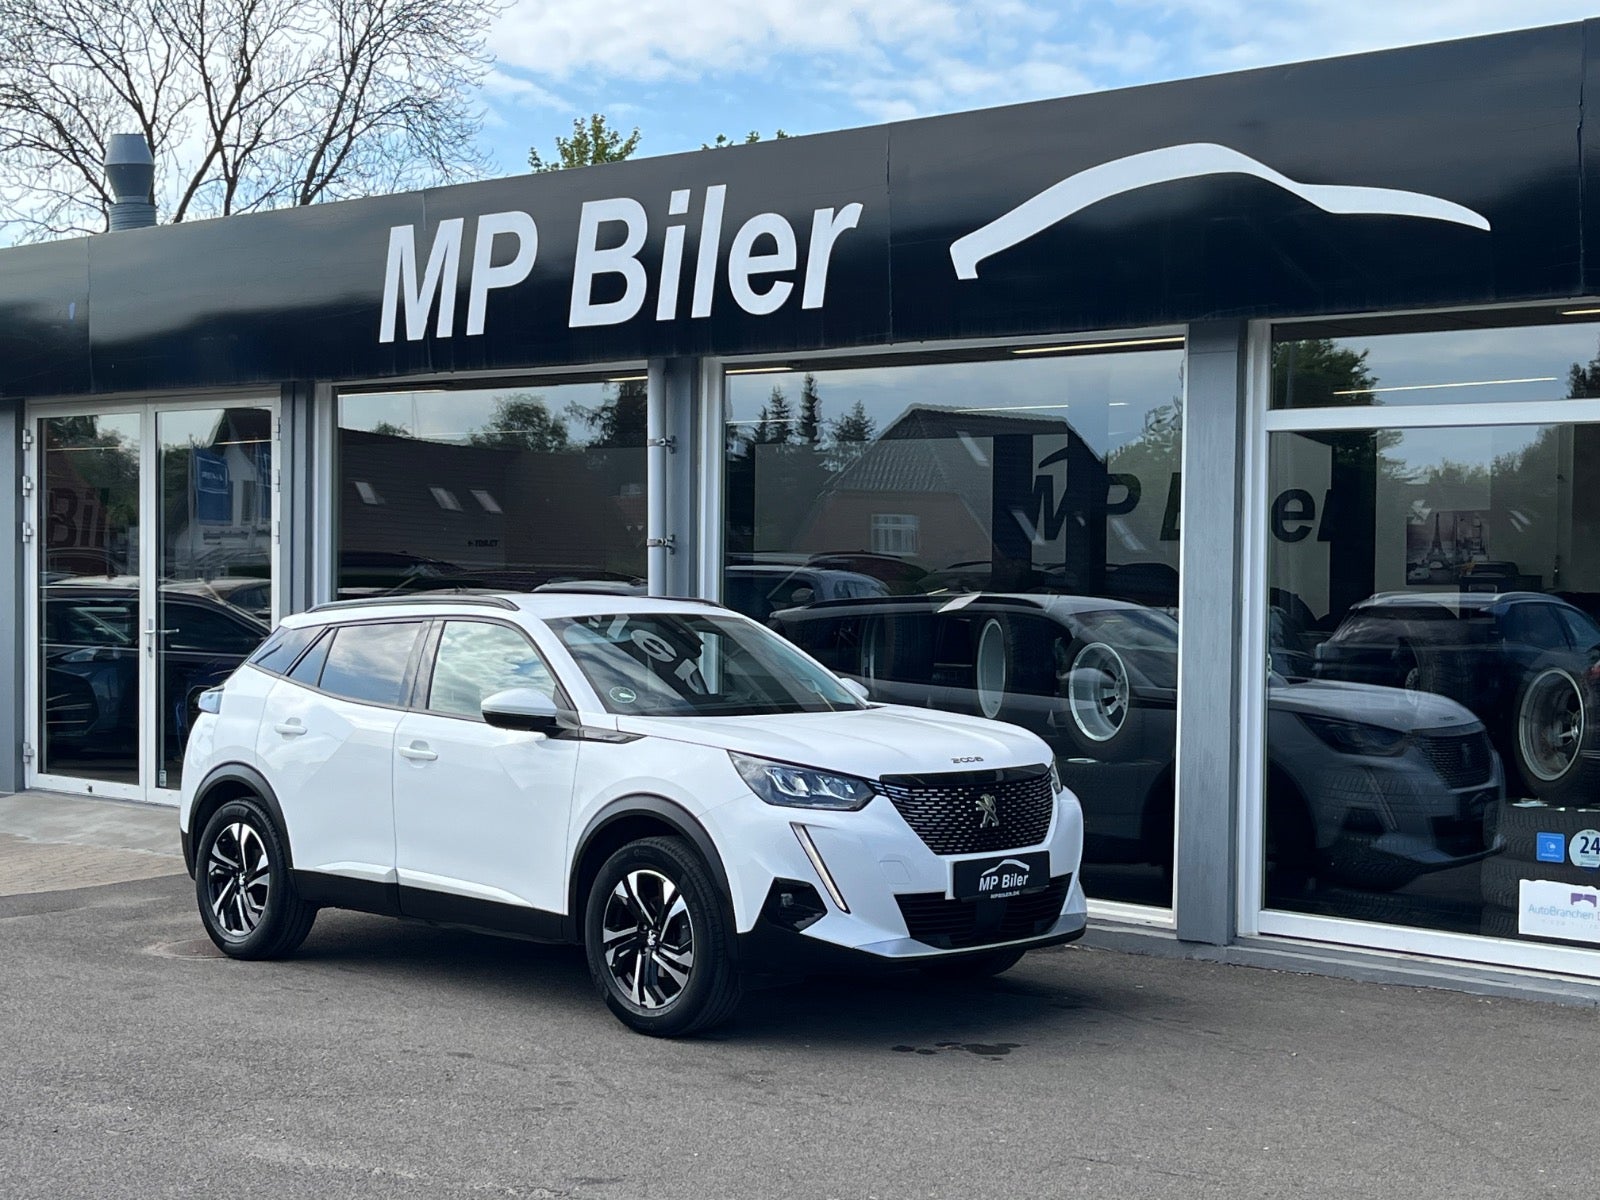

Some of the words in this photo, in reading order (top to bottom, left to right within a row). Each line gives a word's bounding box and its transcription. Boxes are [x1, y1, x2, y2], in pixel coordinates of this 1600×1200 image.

[379, 210, 539, 343] MP
[568, 184, 864, 328] Biler
[978, 875, 999, 892] MP
[1001, 872, 1029, 889] Biler
[1528, 903, 1594, 920] AutoBranchen
